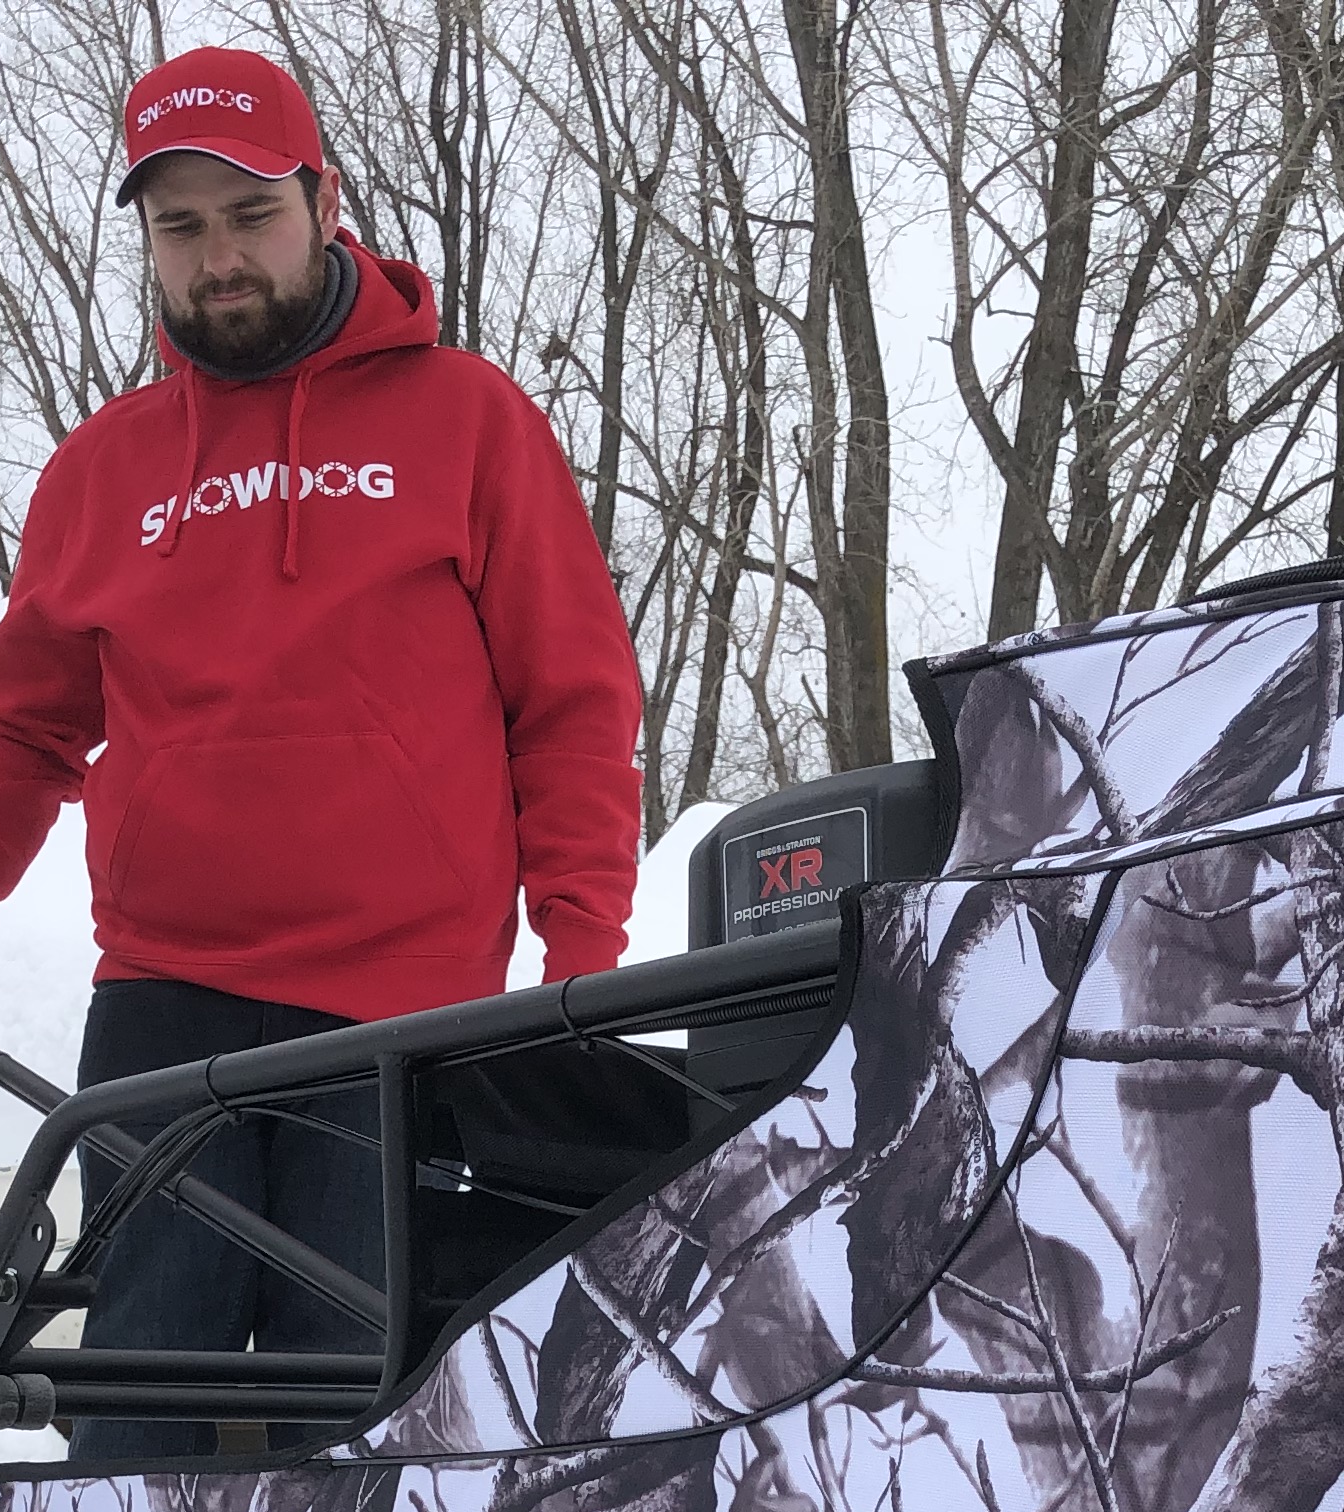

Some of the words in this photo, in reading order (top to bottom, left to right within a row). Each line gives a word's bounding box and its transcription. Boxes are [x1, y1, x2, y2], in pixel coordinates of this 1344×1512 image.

[137, 87, 253, 133] SNOWDOG
[759, 848, 823, 899] XR
[734, 886, 851, 924] PROFESSIONA
